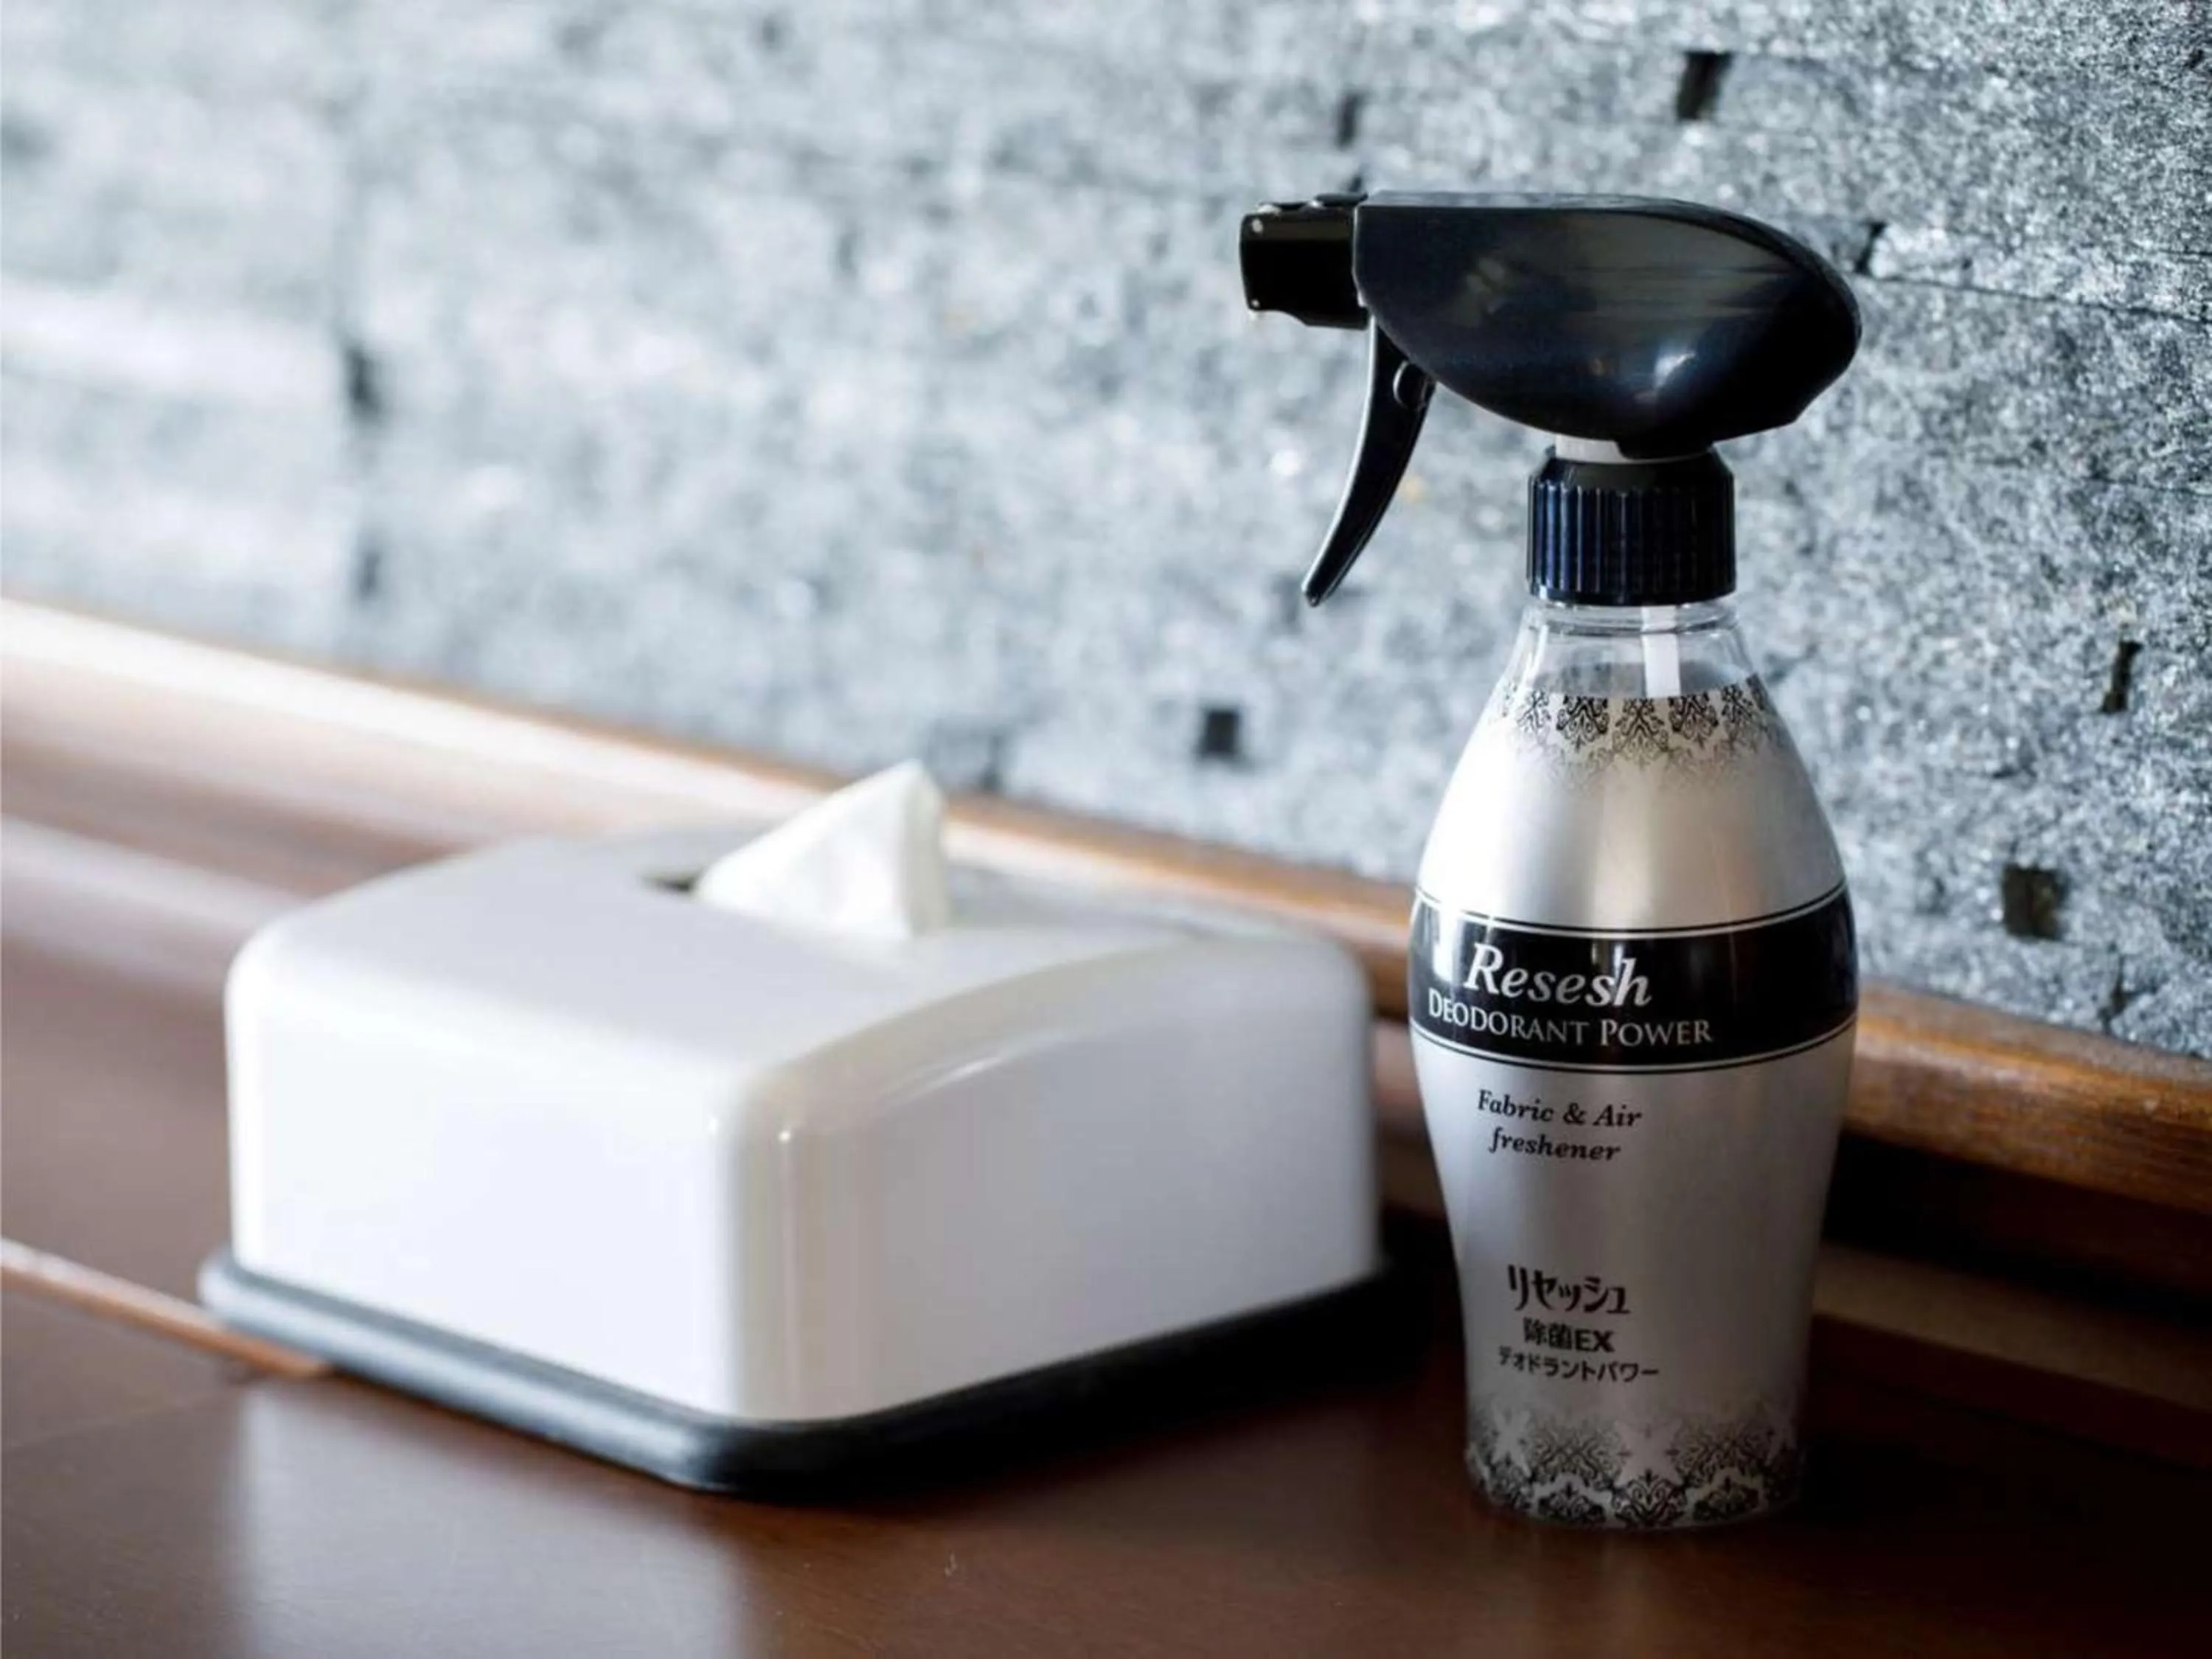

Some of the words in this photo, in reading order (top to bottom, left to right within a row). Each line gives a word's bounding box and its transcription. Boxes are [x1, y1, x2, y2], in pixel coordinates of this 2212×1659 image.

[1464, 943, 1651, 1007] Resesh
[1477, 1088, 1554, 1123] Fabric
[1562, 1103, 1586, 1124] &
[1593, 1105, 1643, 1127] Air
[1489, 1127, 1621, 1161] freshener
[1508, 1264, 1631, 1315] リセッシュ
[1498, 1346, 1659, 1382] デオドラントパワー
